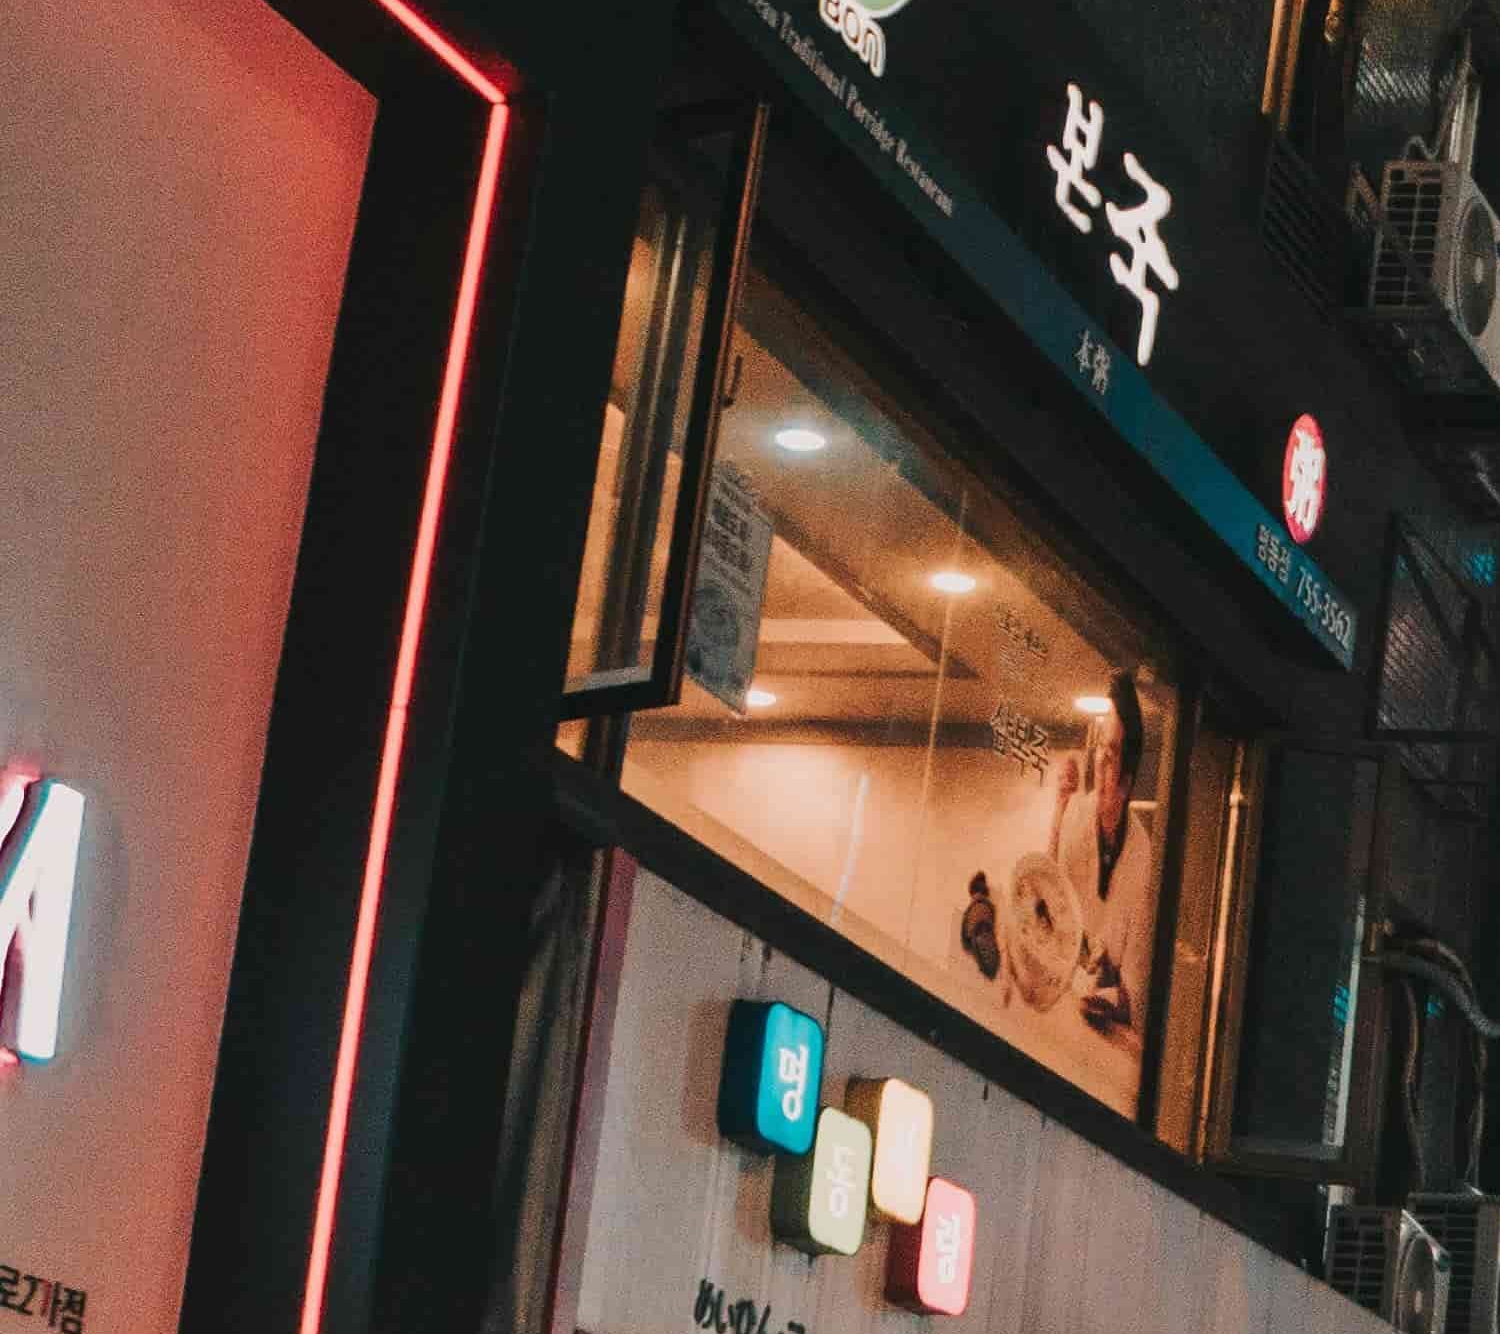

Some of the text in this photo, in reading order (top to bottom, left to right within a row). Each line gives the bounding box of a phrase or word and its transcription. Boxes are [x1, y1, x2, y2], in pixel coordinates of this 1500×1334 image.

[779, 10, 848, 101] Traditional
[846, 82, 896, 153] Porridge
[895, 137, 953, 217] Restaurant
[1045, 81, 1180, 367] 본죽
[1297, 563, 1354, 651] 755-3562
